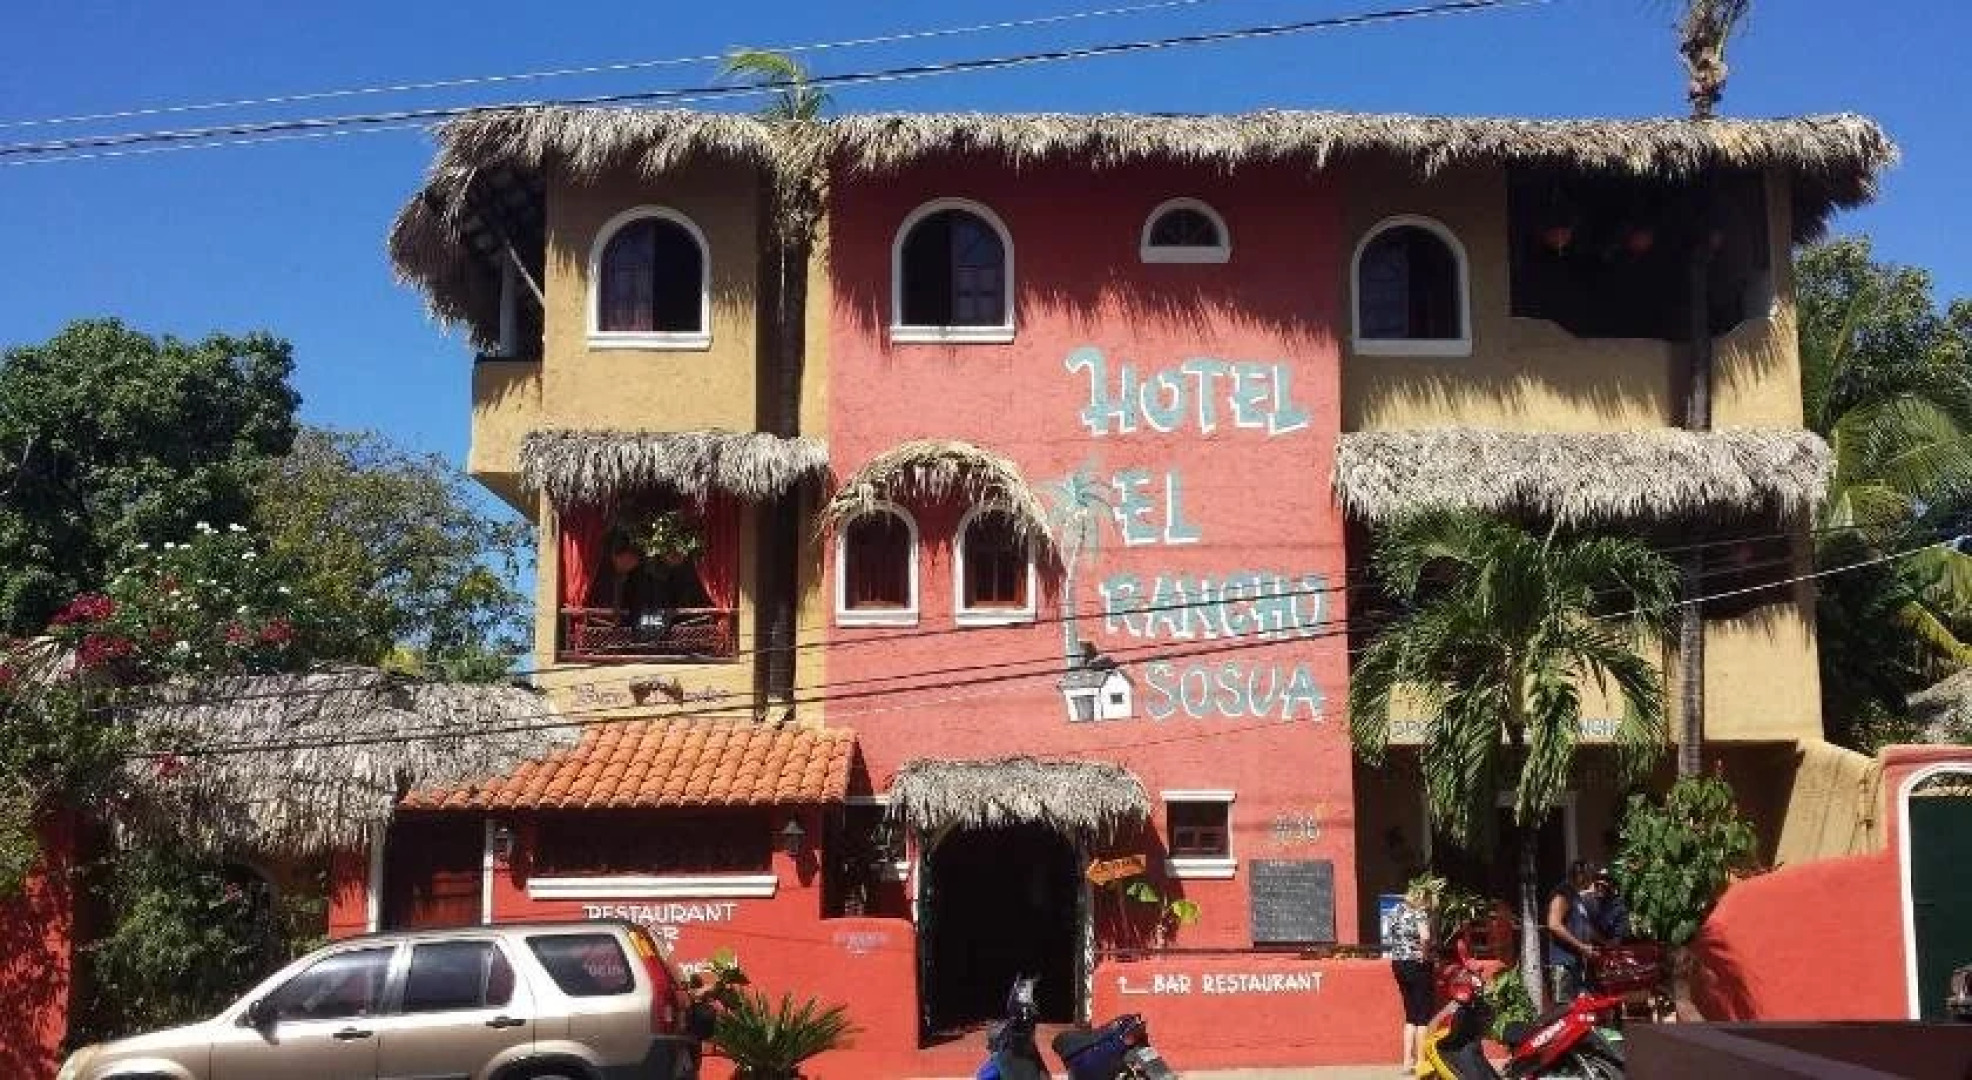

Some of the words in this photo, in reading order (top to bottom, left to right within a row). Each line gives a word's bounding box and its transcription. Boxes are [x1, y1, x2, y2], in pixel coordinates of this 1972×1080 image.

[1065, 346, 1311, 435] HOTEL
[1112, 466, 1201, 545] EL
[1100, 573, 1329, 640] RANCHO
[1145, 662, 1327, 722] SOSUA
[1152, 973, 1192, 994] BAR
[1201, 971, 1323, 995] RESTAURANT
